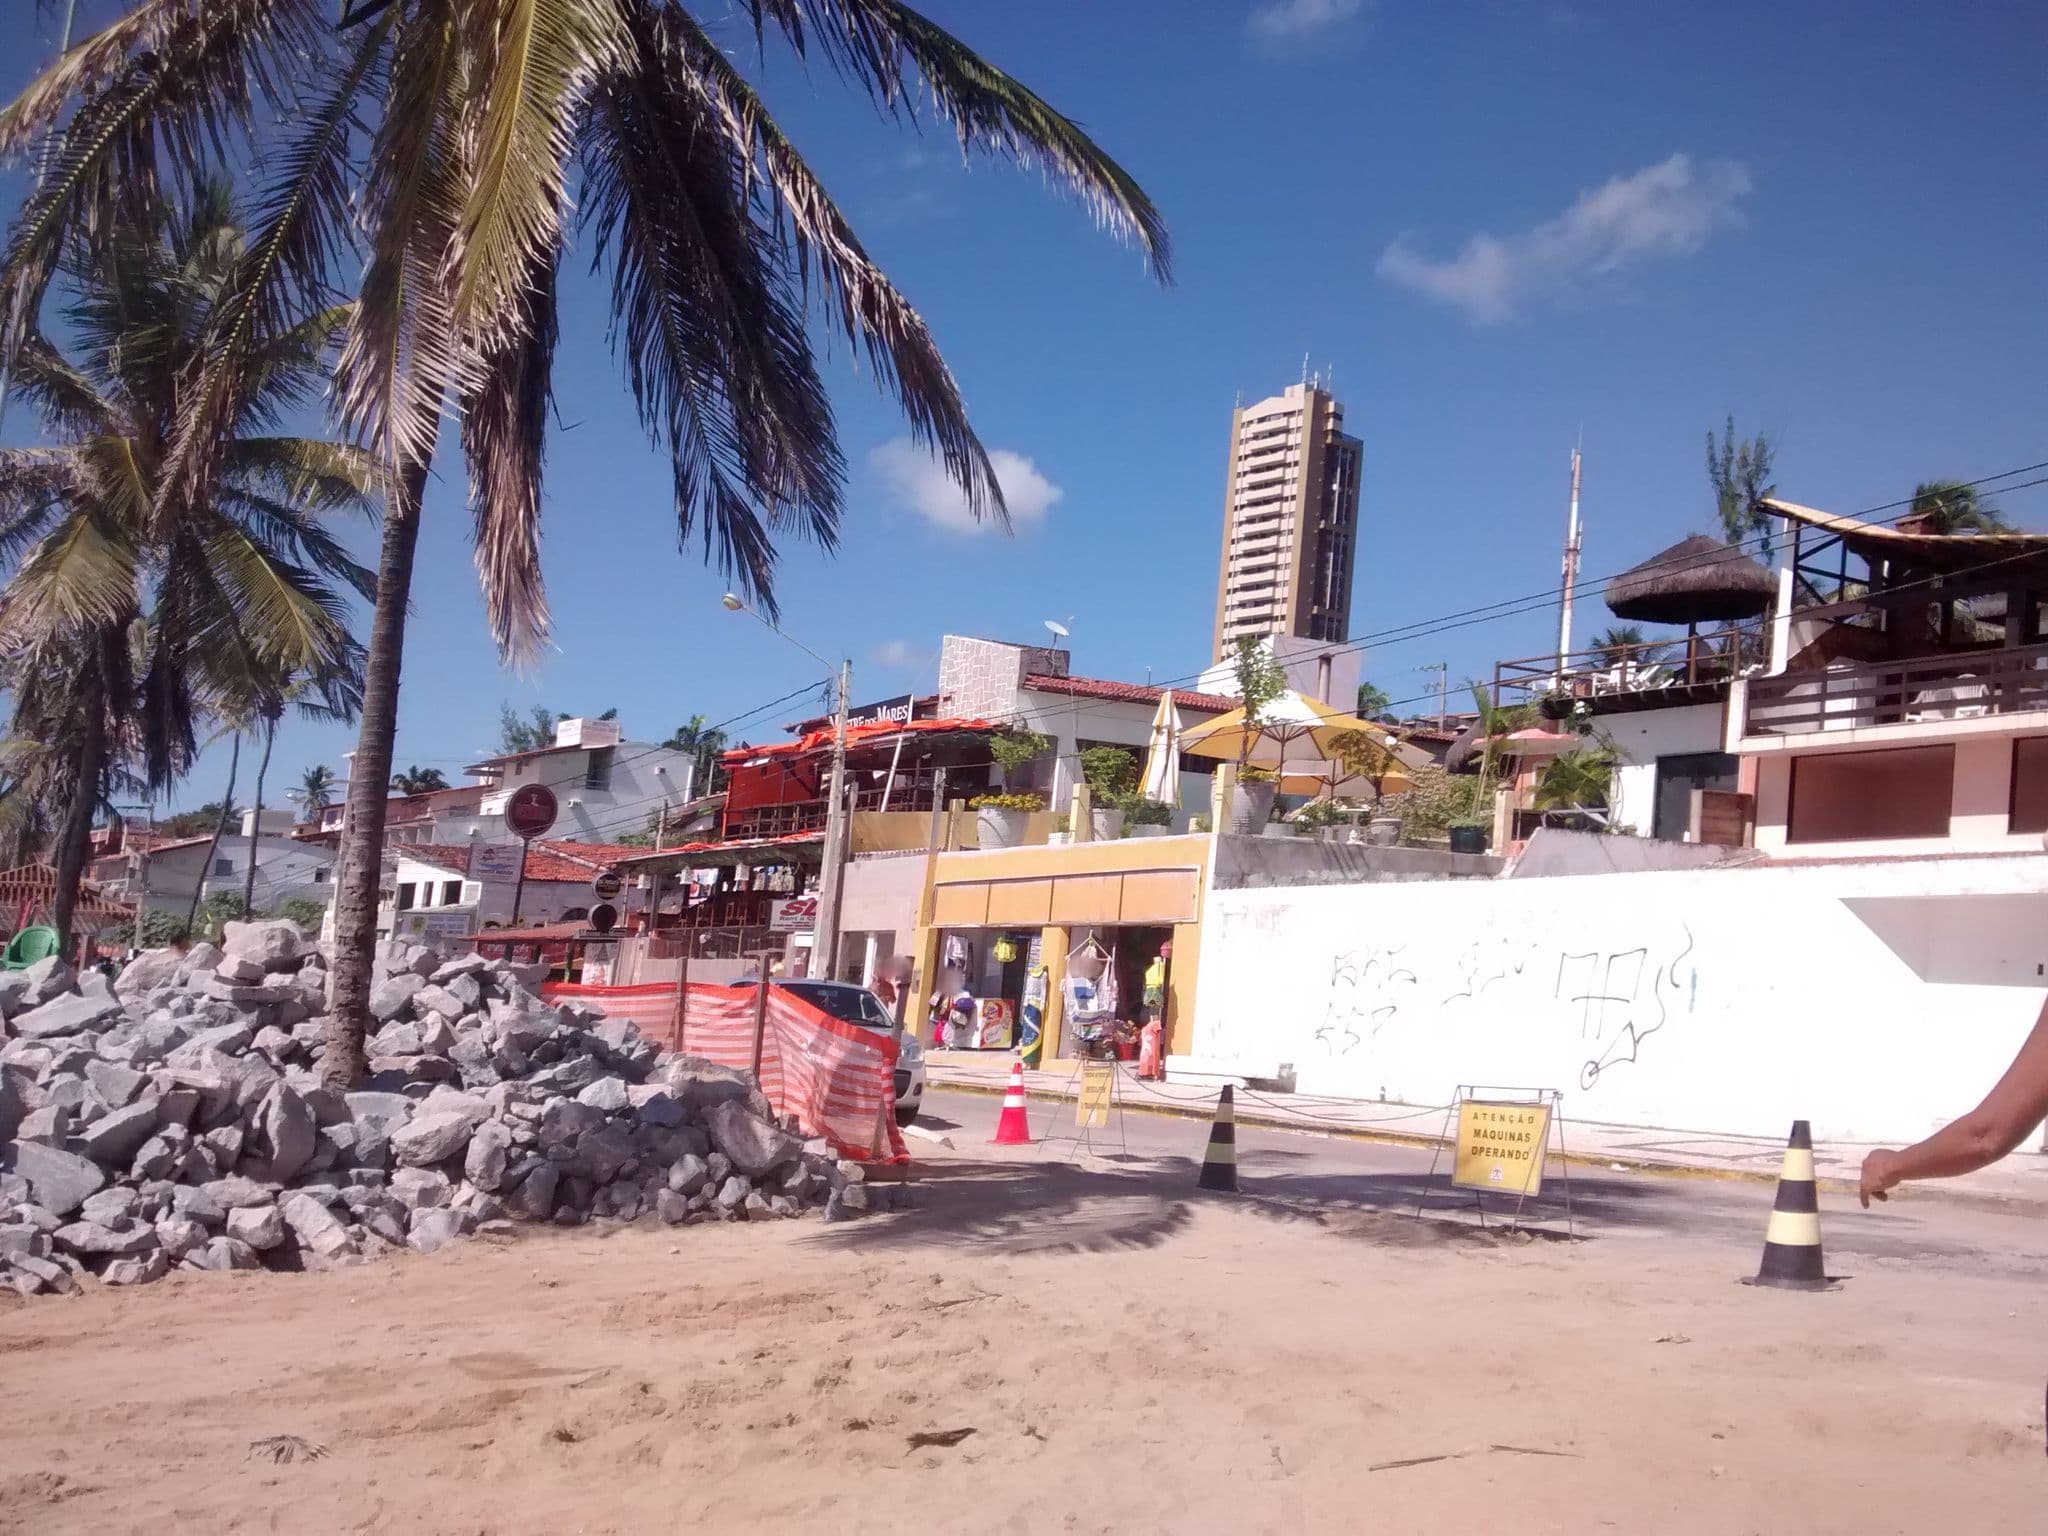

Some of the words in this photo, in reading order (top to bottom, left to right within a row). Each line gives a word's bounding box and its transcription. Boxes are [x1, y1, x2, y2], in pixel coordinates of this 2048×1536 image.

[877, 704, 909, 723] MARES
[1473, 1112, 1535, 1125] ATENÇÃO
[1473, 1127, 1531, 1143] MÁQUINAS
[1471, 1146, 1530, 1161] OPERANDO
